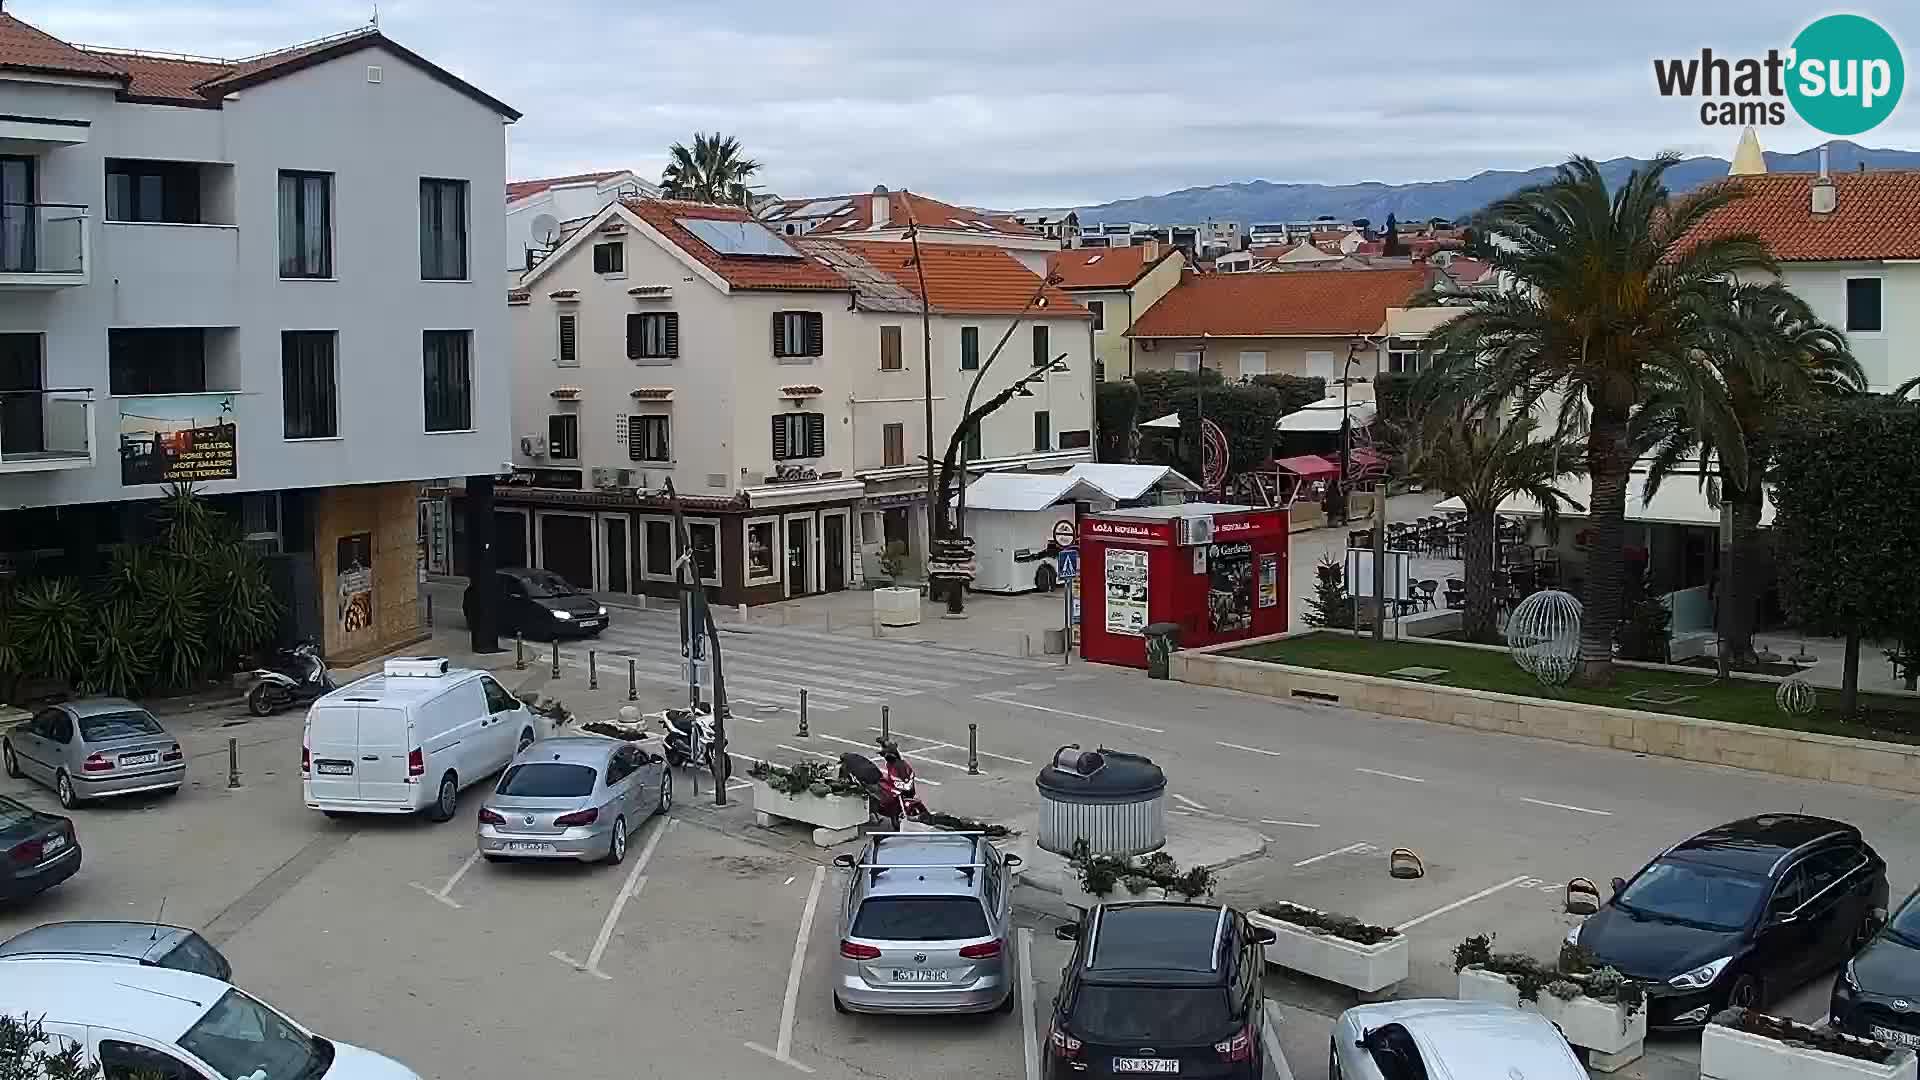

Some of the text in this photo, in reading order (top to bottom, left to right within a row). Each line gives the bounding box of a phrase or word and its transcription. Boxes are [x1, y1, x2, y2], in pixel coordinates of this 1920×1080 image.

[215, 450, 232, 458] THE
[173, 459, 232, 470] MOST AMAZING
